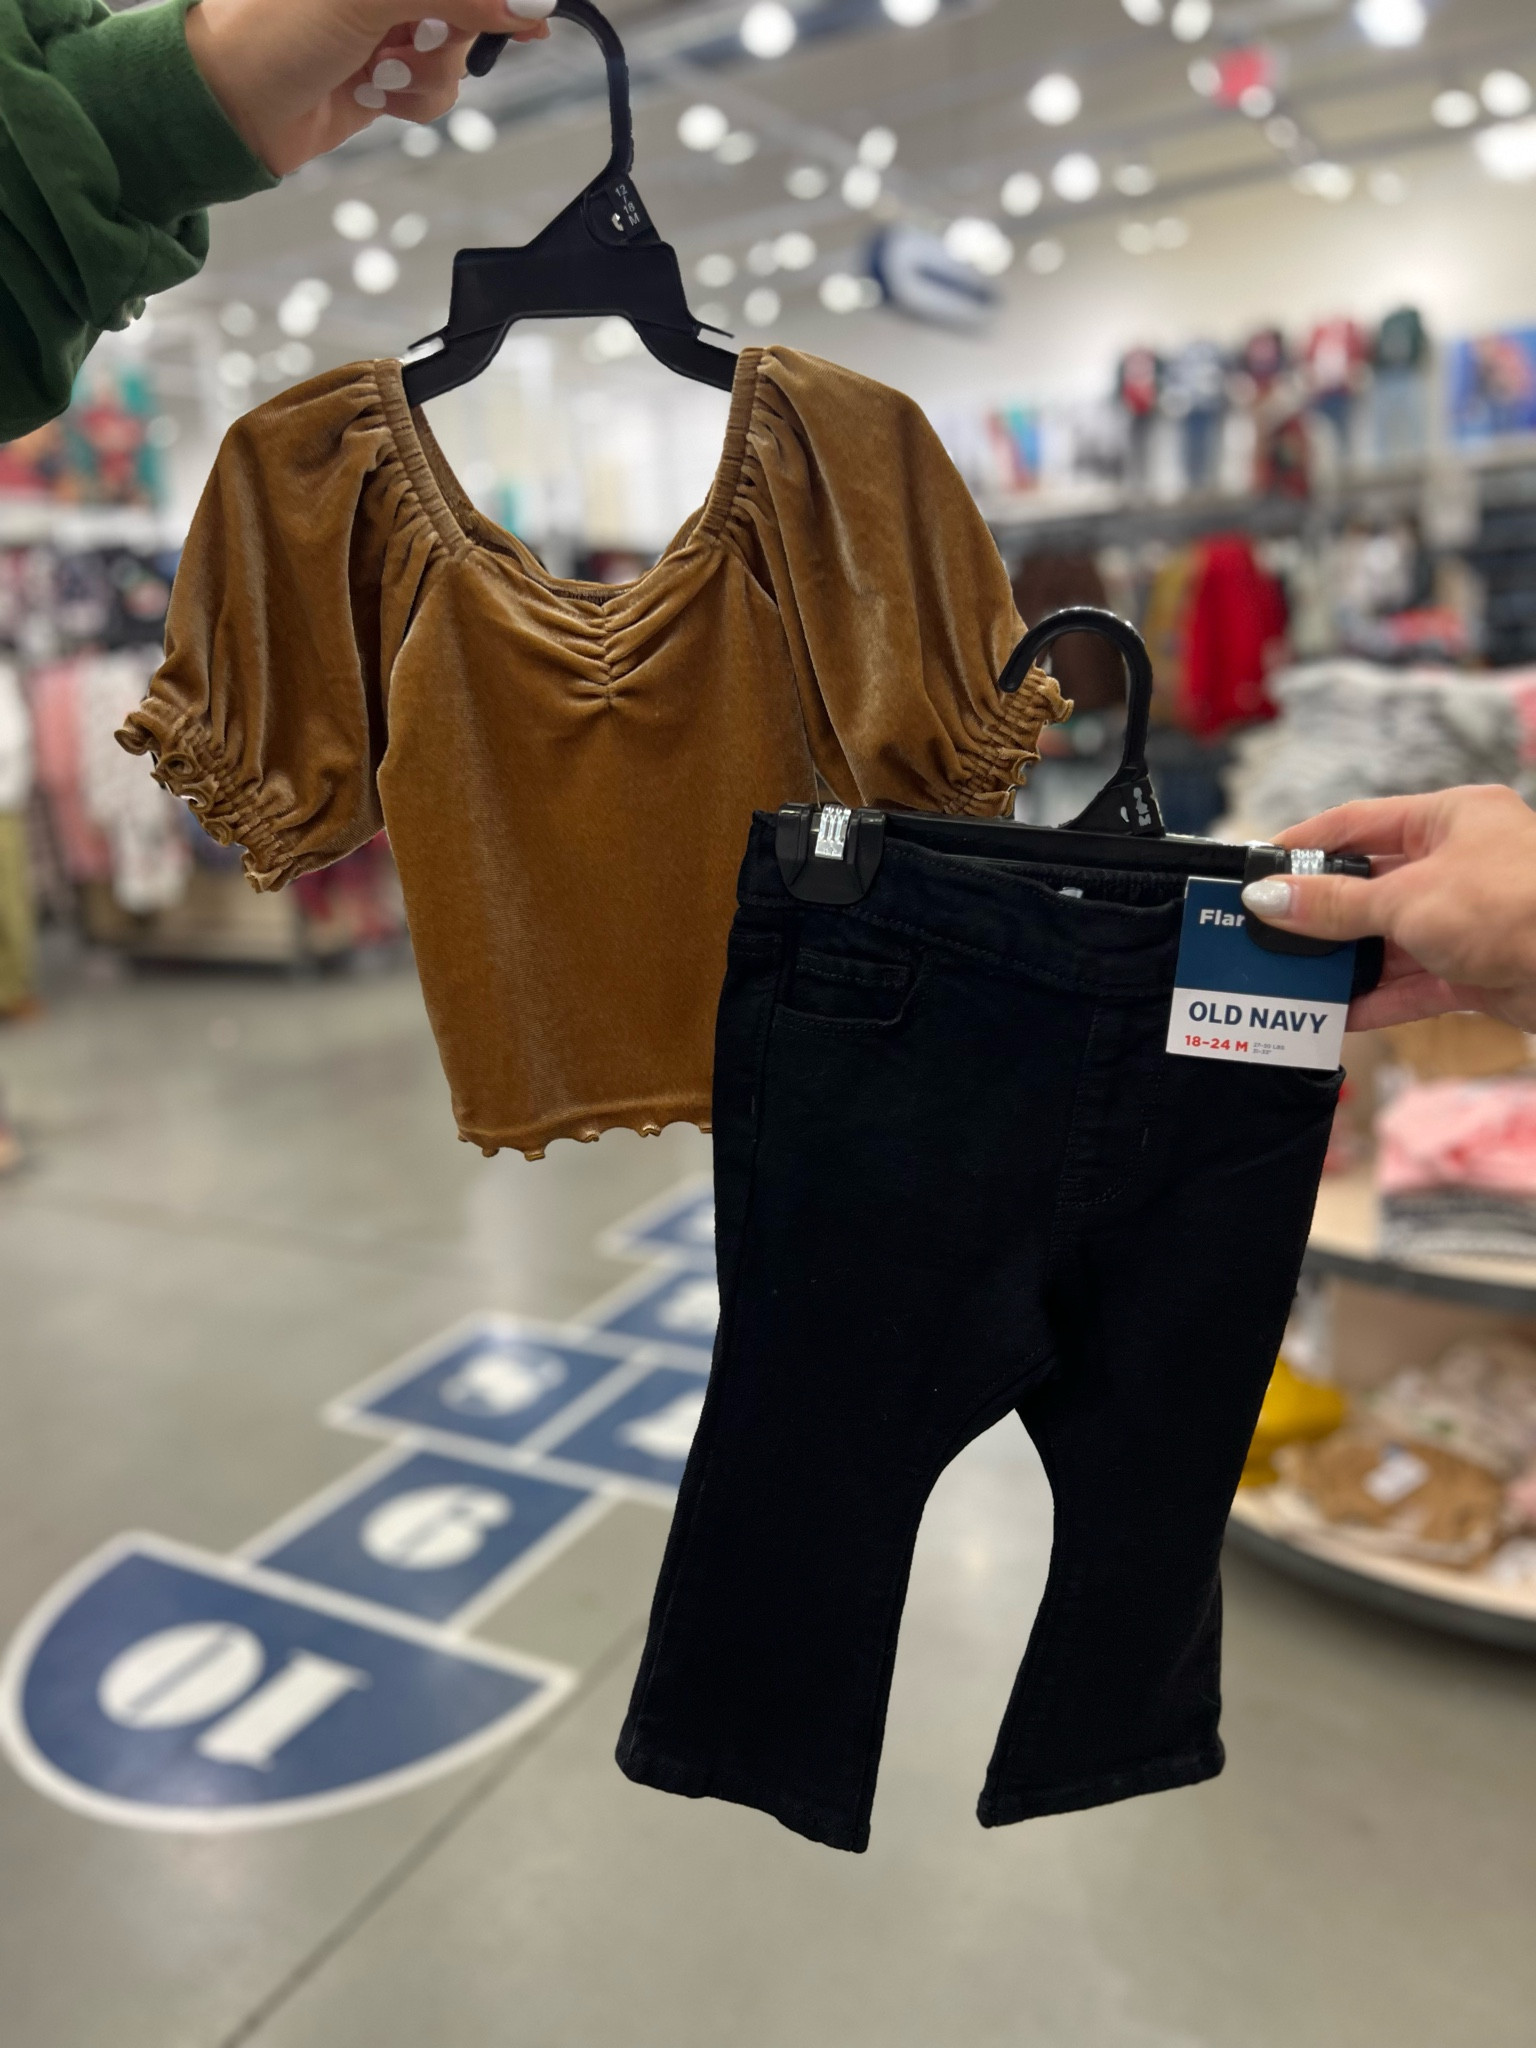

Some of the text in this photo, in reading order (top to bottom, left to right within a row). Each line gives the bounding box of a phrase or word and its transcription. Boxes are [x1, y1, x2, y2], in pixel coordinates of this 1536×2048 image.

[628, 212, 641, 226] M
[1199, 908, 1246, 927] Flar
[1188, 1000, 1328, 1034] OLD NAVY
[1184, 1035, 1248, 1053] 18-24 M
[97, 1620, 371, 1772] 10
